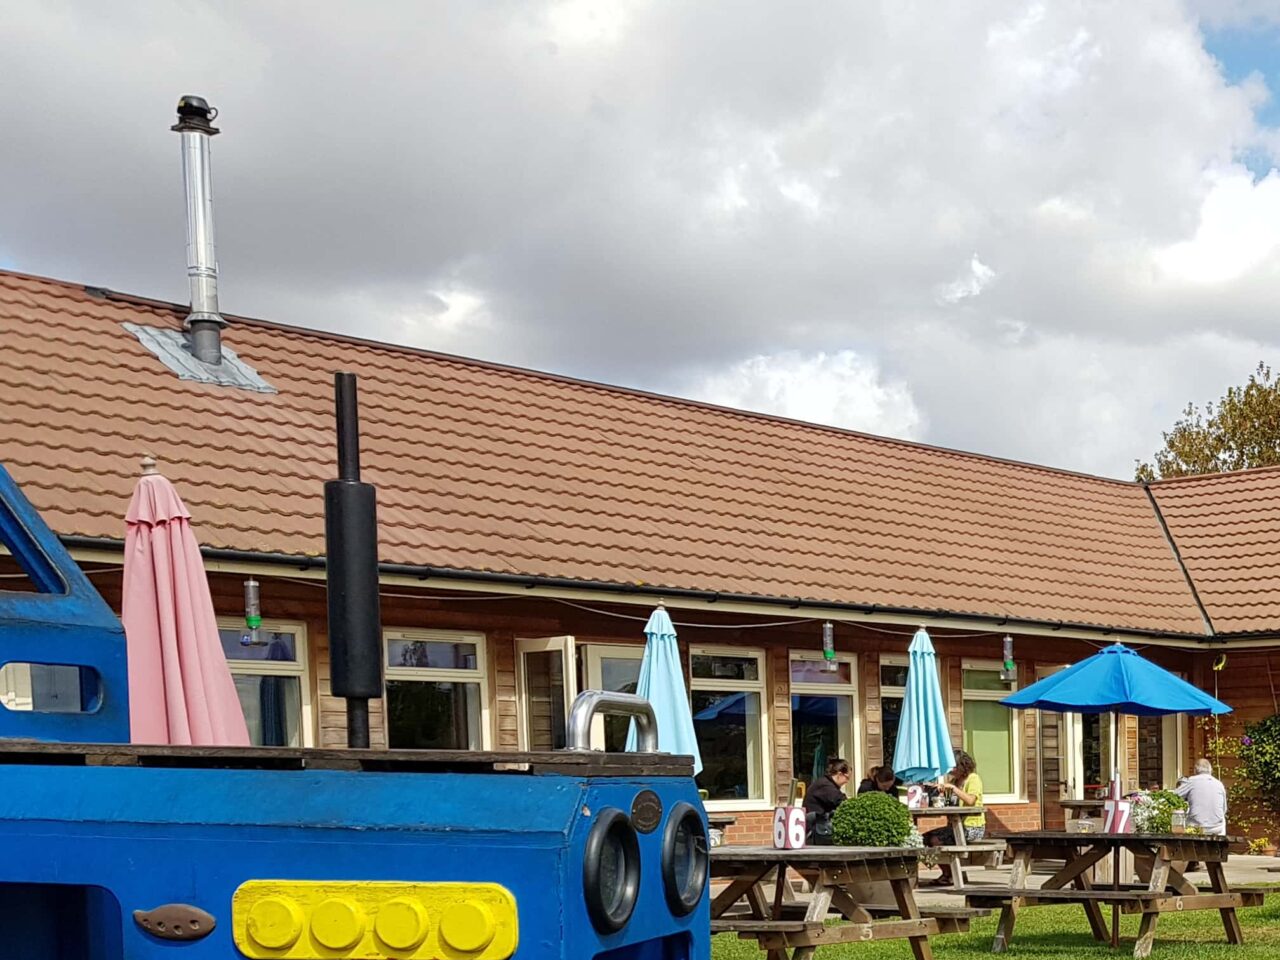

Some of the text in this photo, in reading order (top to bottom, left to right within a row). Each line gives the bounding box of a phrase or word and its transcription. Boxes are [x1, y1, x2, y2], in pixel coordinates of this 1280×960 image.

[908, 785, 923, 808] 2
[1176, 896, 1184, 911] 6
[861, 923, 873, 941] 5
